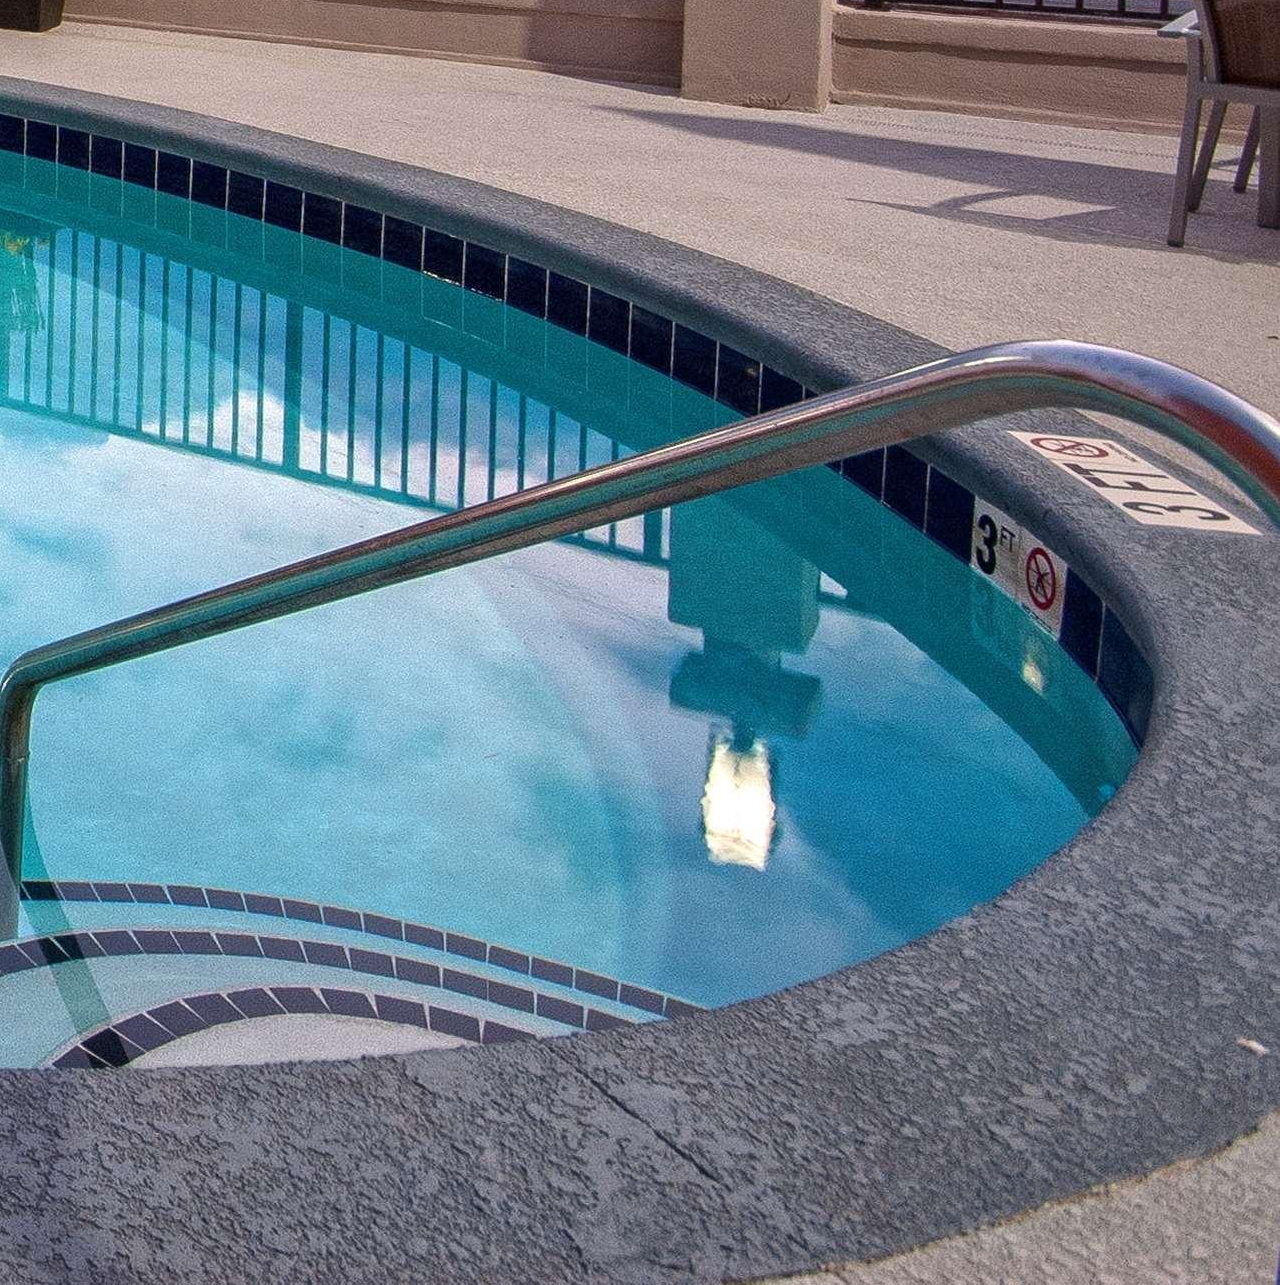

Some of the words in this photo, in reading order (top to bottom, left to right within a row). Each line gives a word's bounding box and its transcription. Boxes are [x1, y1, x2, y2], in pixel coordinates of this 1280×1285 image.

[1062, 463, 1198, 497] FT
[1122, 501, 1231, 521] 3
[976, 514, 998, 575] 3
[1000, 525, 1017, 552] FT
